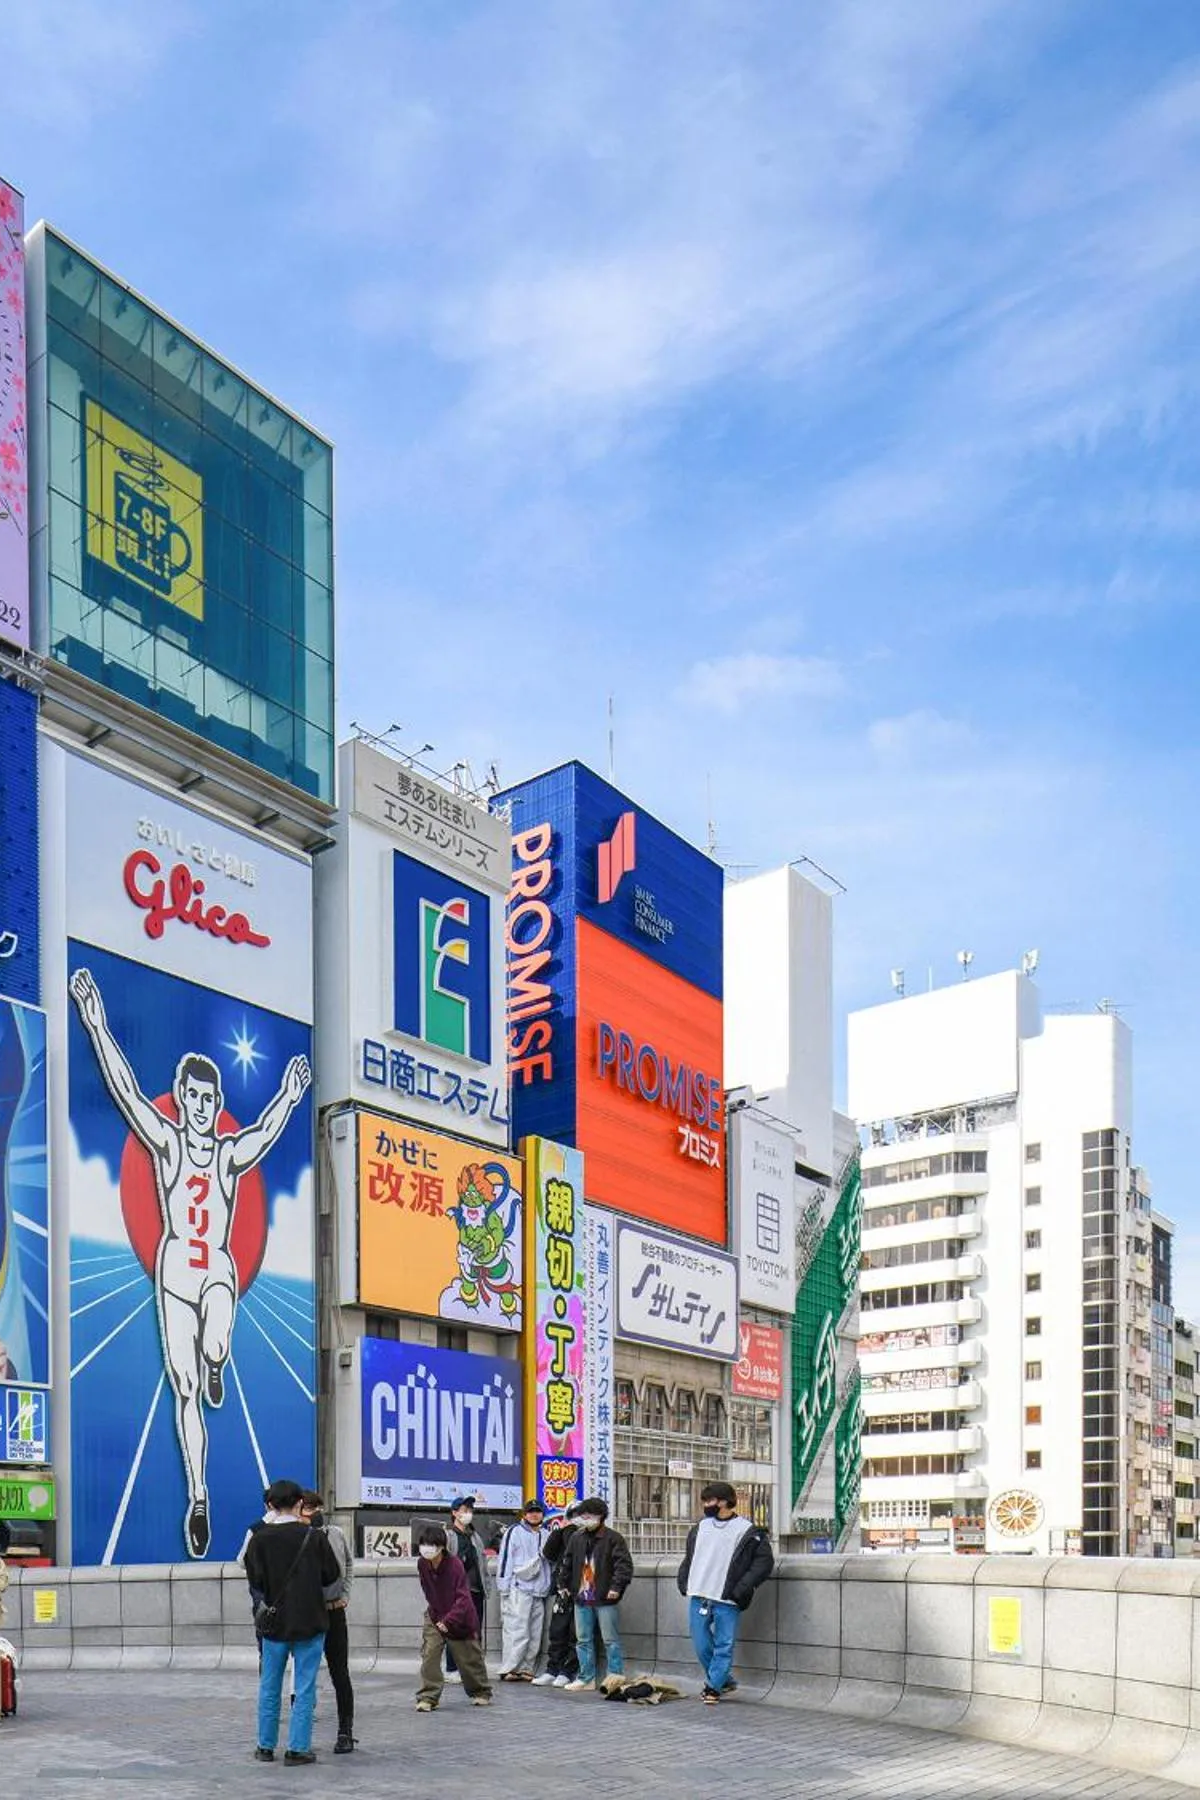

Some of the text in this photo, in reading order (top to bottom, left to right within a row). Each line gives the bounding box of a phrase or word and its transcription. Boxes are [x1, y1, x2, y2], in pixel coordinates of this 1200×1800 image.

[383, 799, 490, 872] エステムシリーズ
[397, 770, 477, 831] 夢ある住まい
[136, 815, 256, 888] おいしさと健康
[123, 848, 271, 948] Glico
[505, 822, 553, 1085] PROMISE
[363, 1038, 511, 1126] 日商エステム
[598, 1019, 721, 1132] PROMISE
[375, 1130, 439, 1171] かぜに
[677, 1124, 721, 1169] プロミス
[185, 1172, 211, 1271] グリコ
[367, 1159, 446, 1218] 改源
[545, 1177, 576, 1435] 親切・丁寧
[370, 1362, 514, 1466] CHINTAI
[542, 1460, 578, 1483] ひまわり
